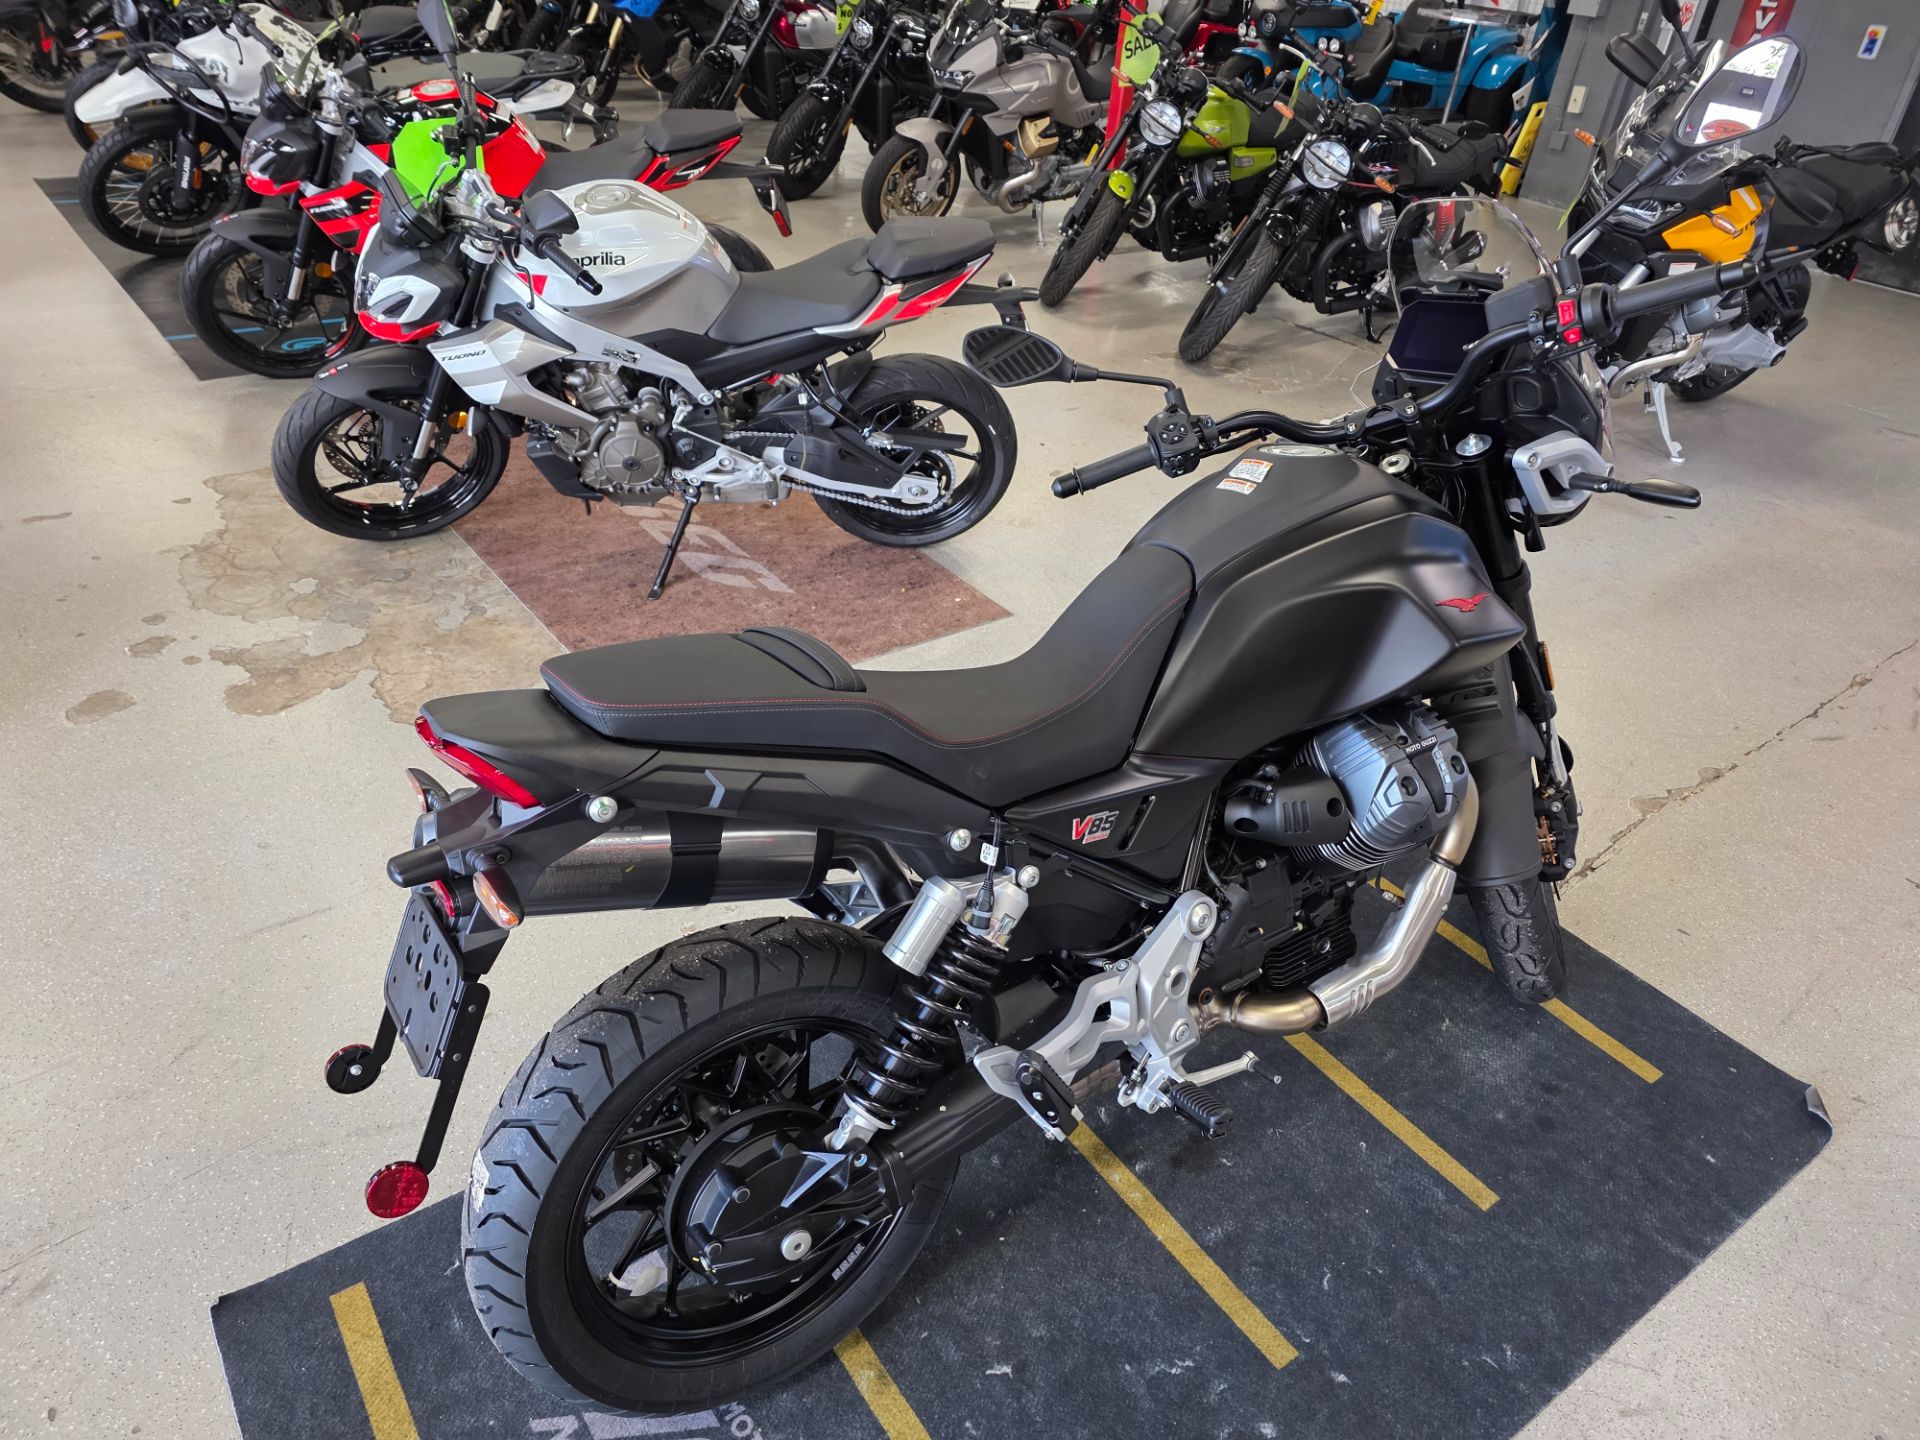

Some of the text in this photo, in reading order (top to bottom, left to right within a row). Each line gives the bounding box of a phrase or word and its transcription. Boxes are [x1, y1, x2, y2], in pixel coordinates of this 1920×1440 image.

[441, 349, 487, 362] TUONO
[1405, 743, 1421, 753] MOTO
[1072, 810, 1120, 841] V85
